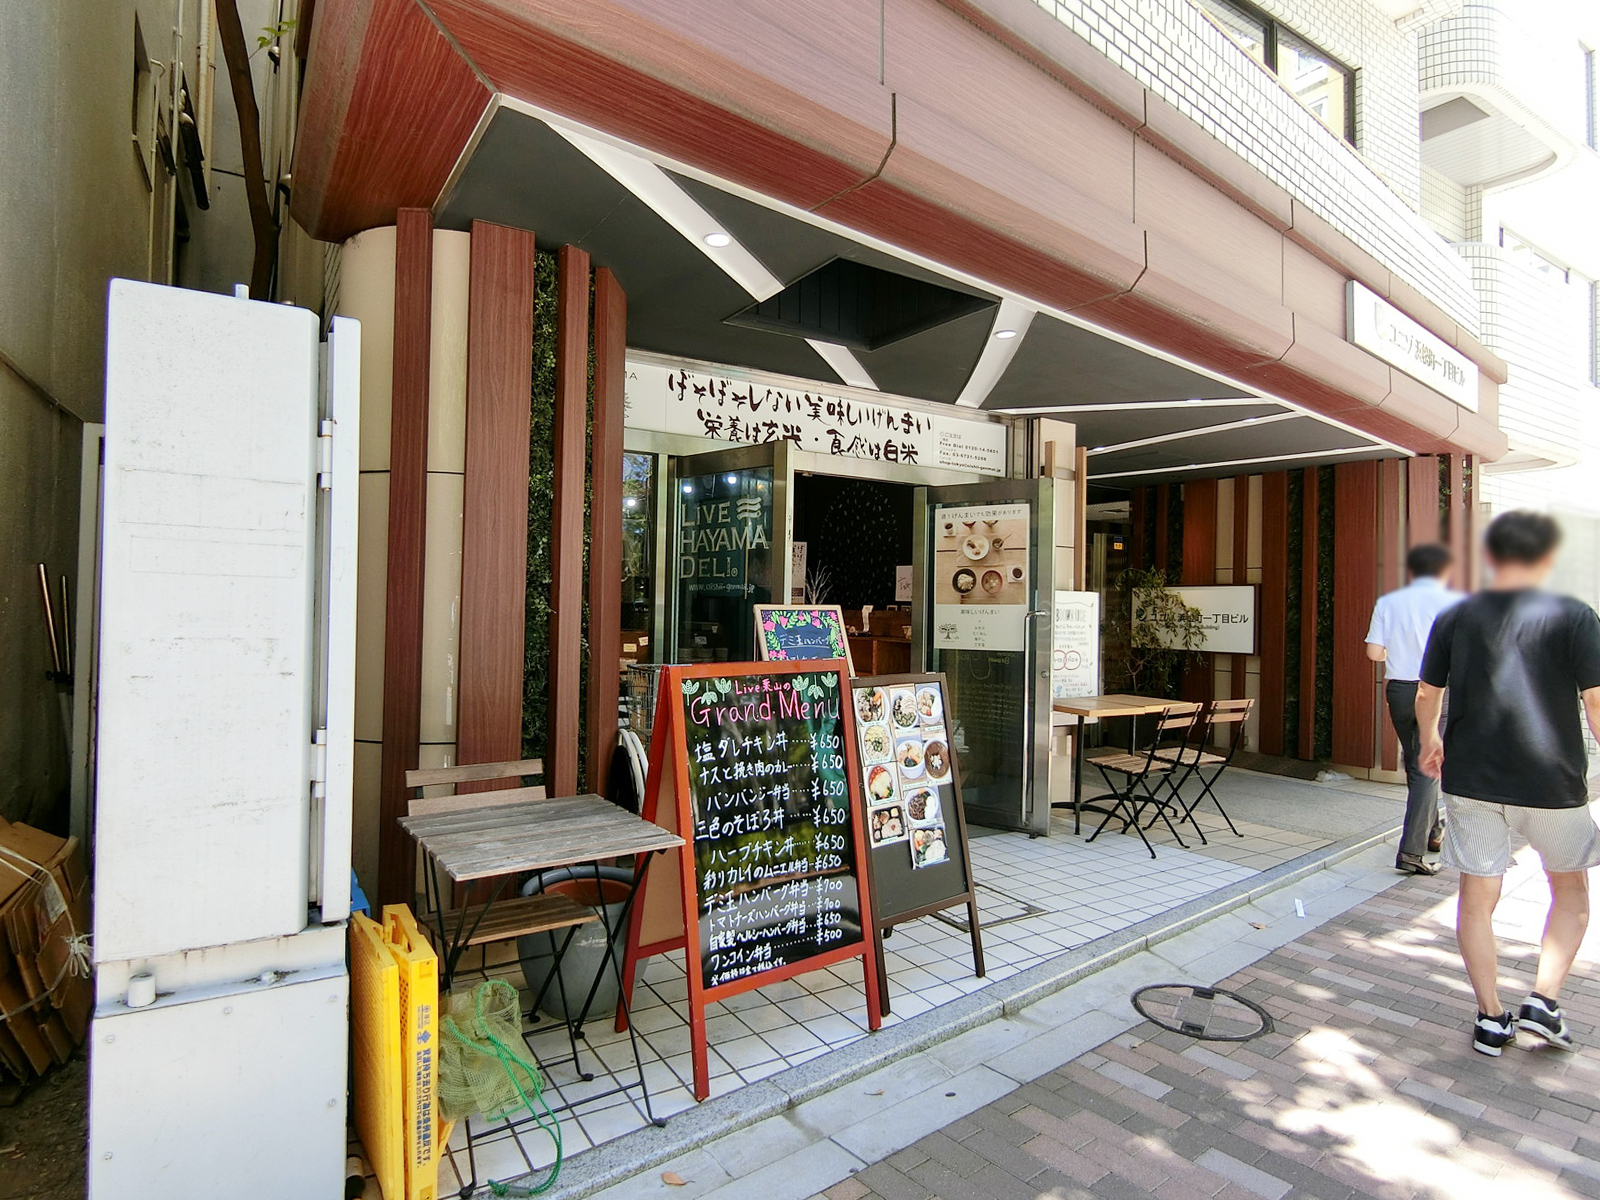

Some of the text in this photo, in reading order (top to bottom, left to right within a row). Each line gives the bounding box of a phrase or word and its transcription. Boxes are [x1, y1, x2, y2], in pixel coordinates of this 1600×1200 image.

[680, 524, 769, 553] HAYAMA
[690, 689, 840, 728] Grand Menu
[706, 783, 790, 811] バンバンジー弁当
[710, 835, 794, 865] ハーブチキン丼
[711, 942, 772, 971] ワンコイン弁当
